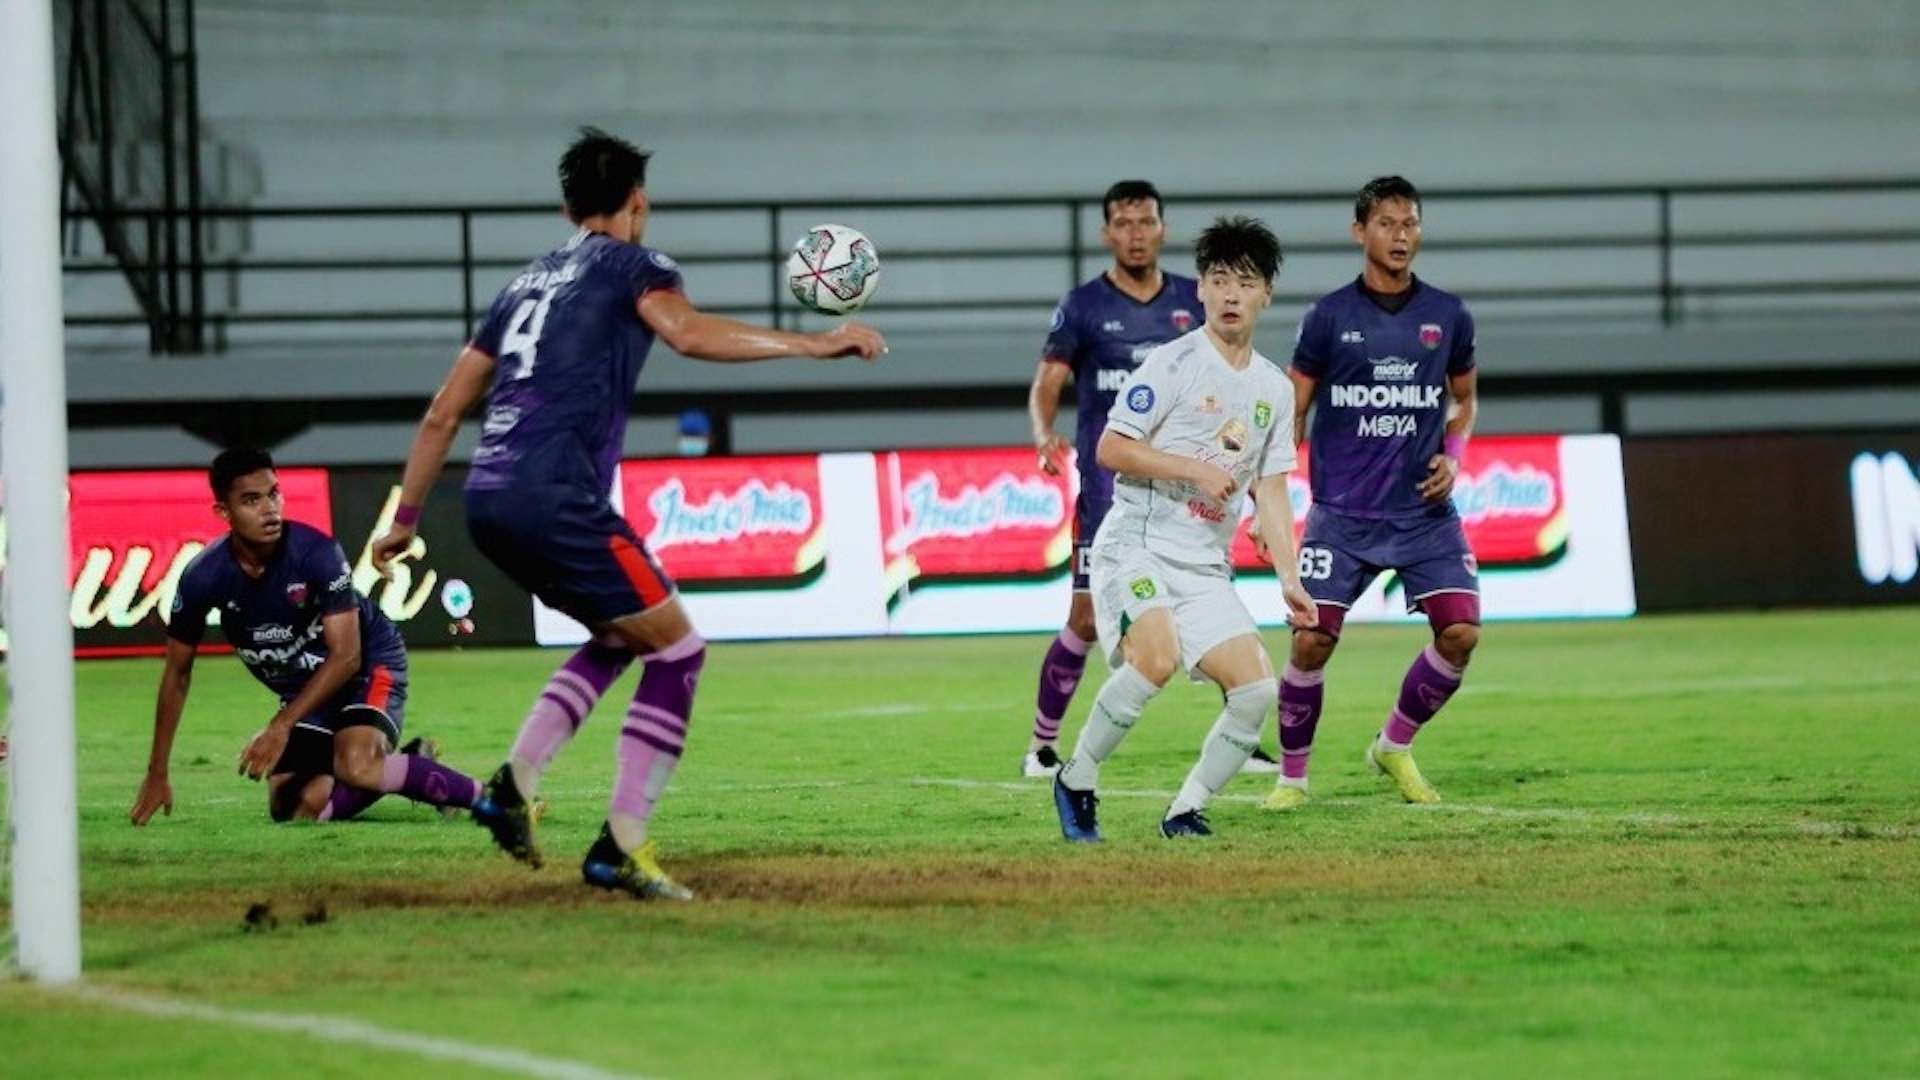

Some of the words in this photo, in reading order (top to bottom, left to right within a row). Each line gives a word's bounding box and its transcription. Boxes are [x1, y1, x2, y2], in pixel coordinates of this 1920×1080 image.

[501, 287, 556, 379] 4
[1331, 384, 1443, 408] INDOMILK
[1357, 414, 1417, 437] MOYA
[1299, 546, 1333, 580] 63
